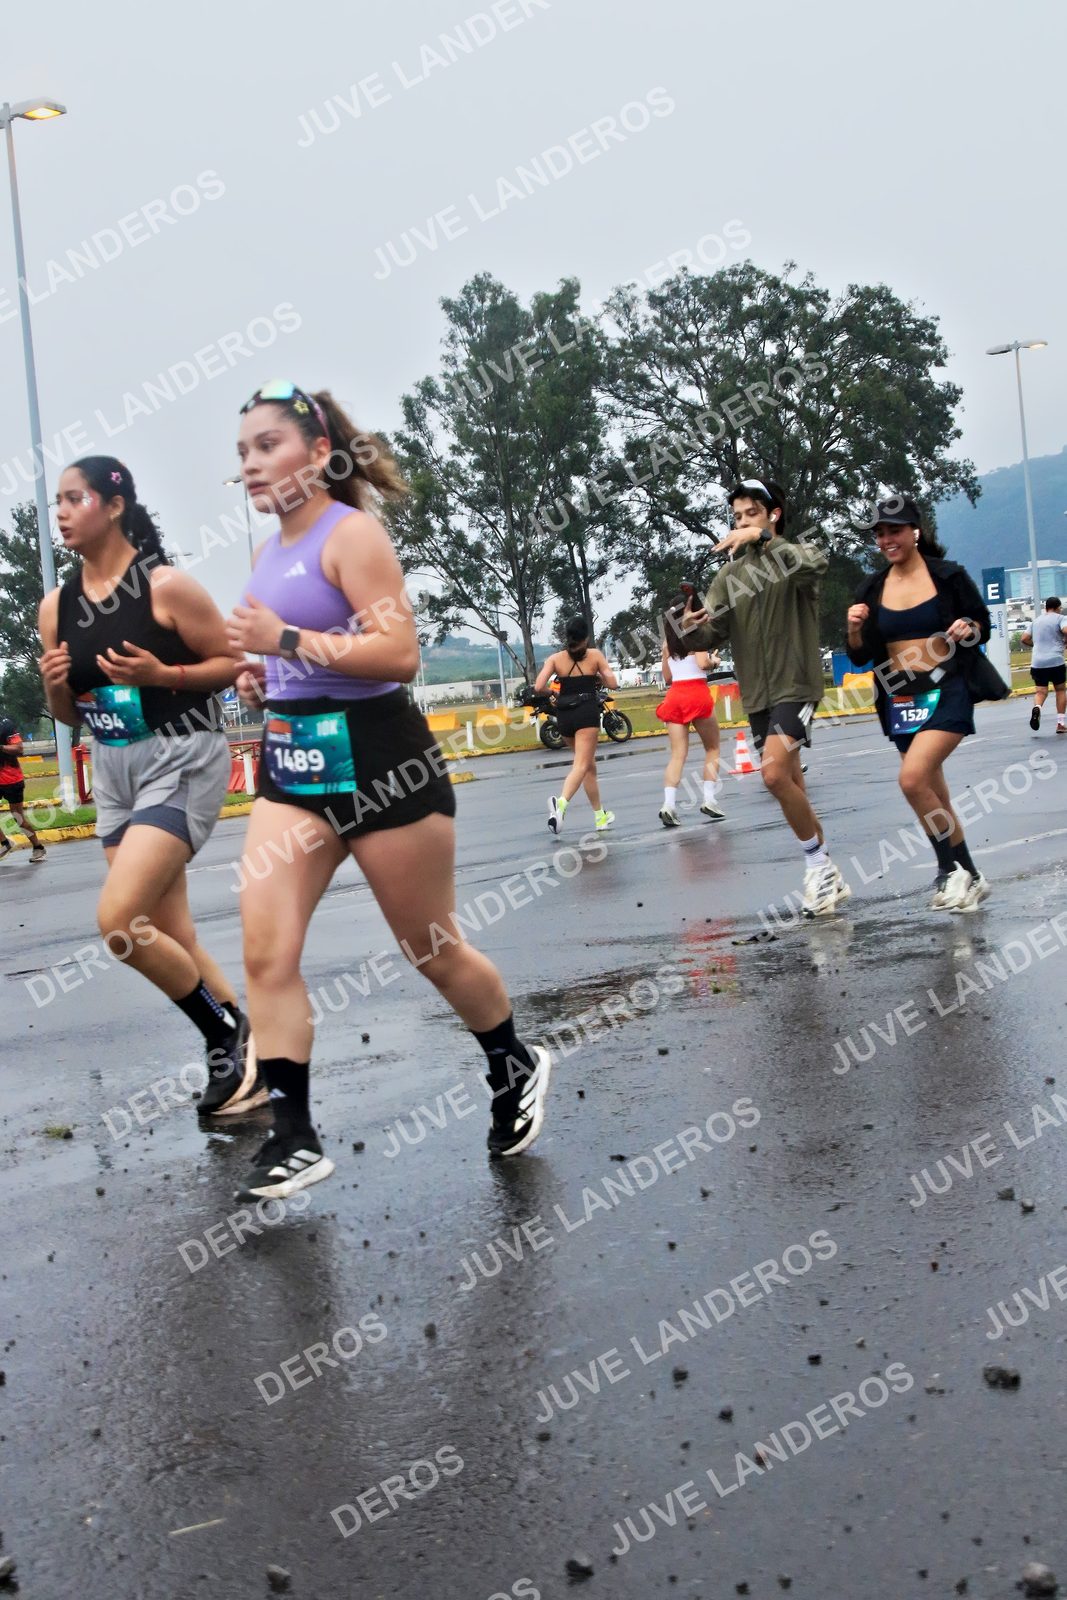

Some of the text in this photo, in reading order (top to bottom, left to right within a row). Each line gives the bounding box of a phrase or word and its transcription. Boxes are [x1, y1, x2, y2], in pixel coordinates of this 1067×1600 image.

[987, 583, 1000, 600] E
[84, 712, 125, 730] 1494
[900, 708, 929, 722] 1528
[274, 747, 326, 772] 1489
